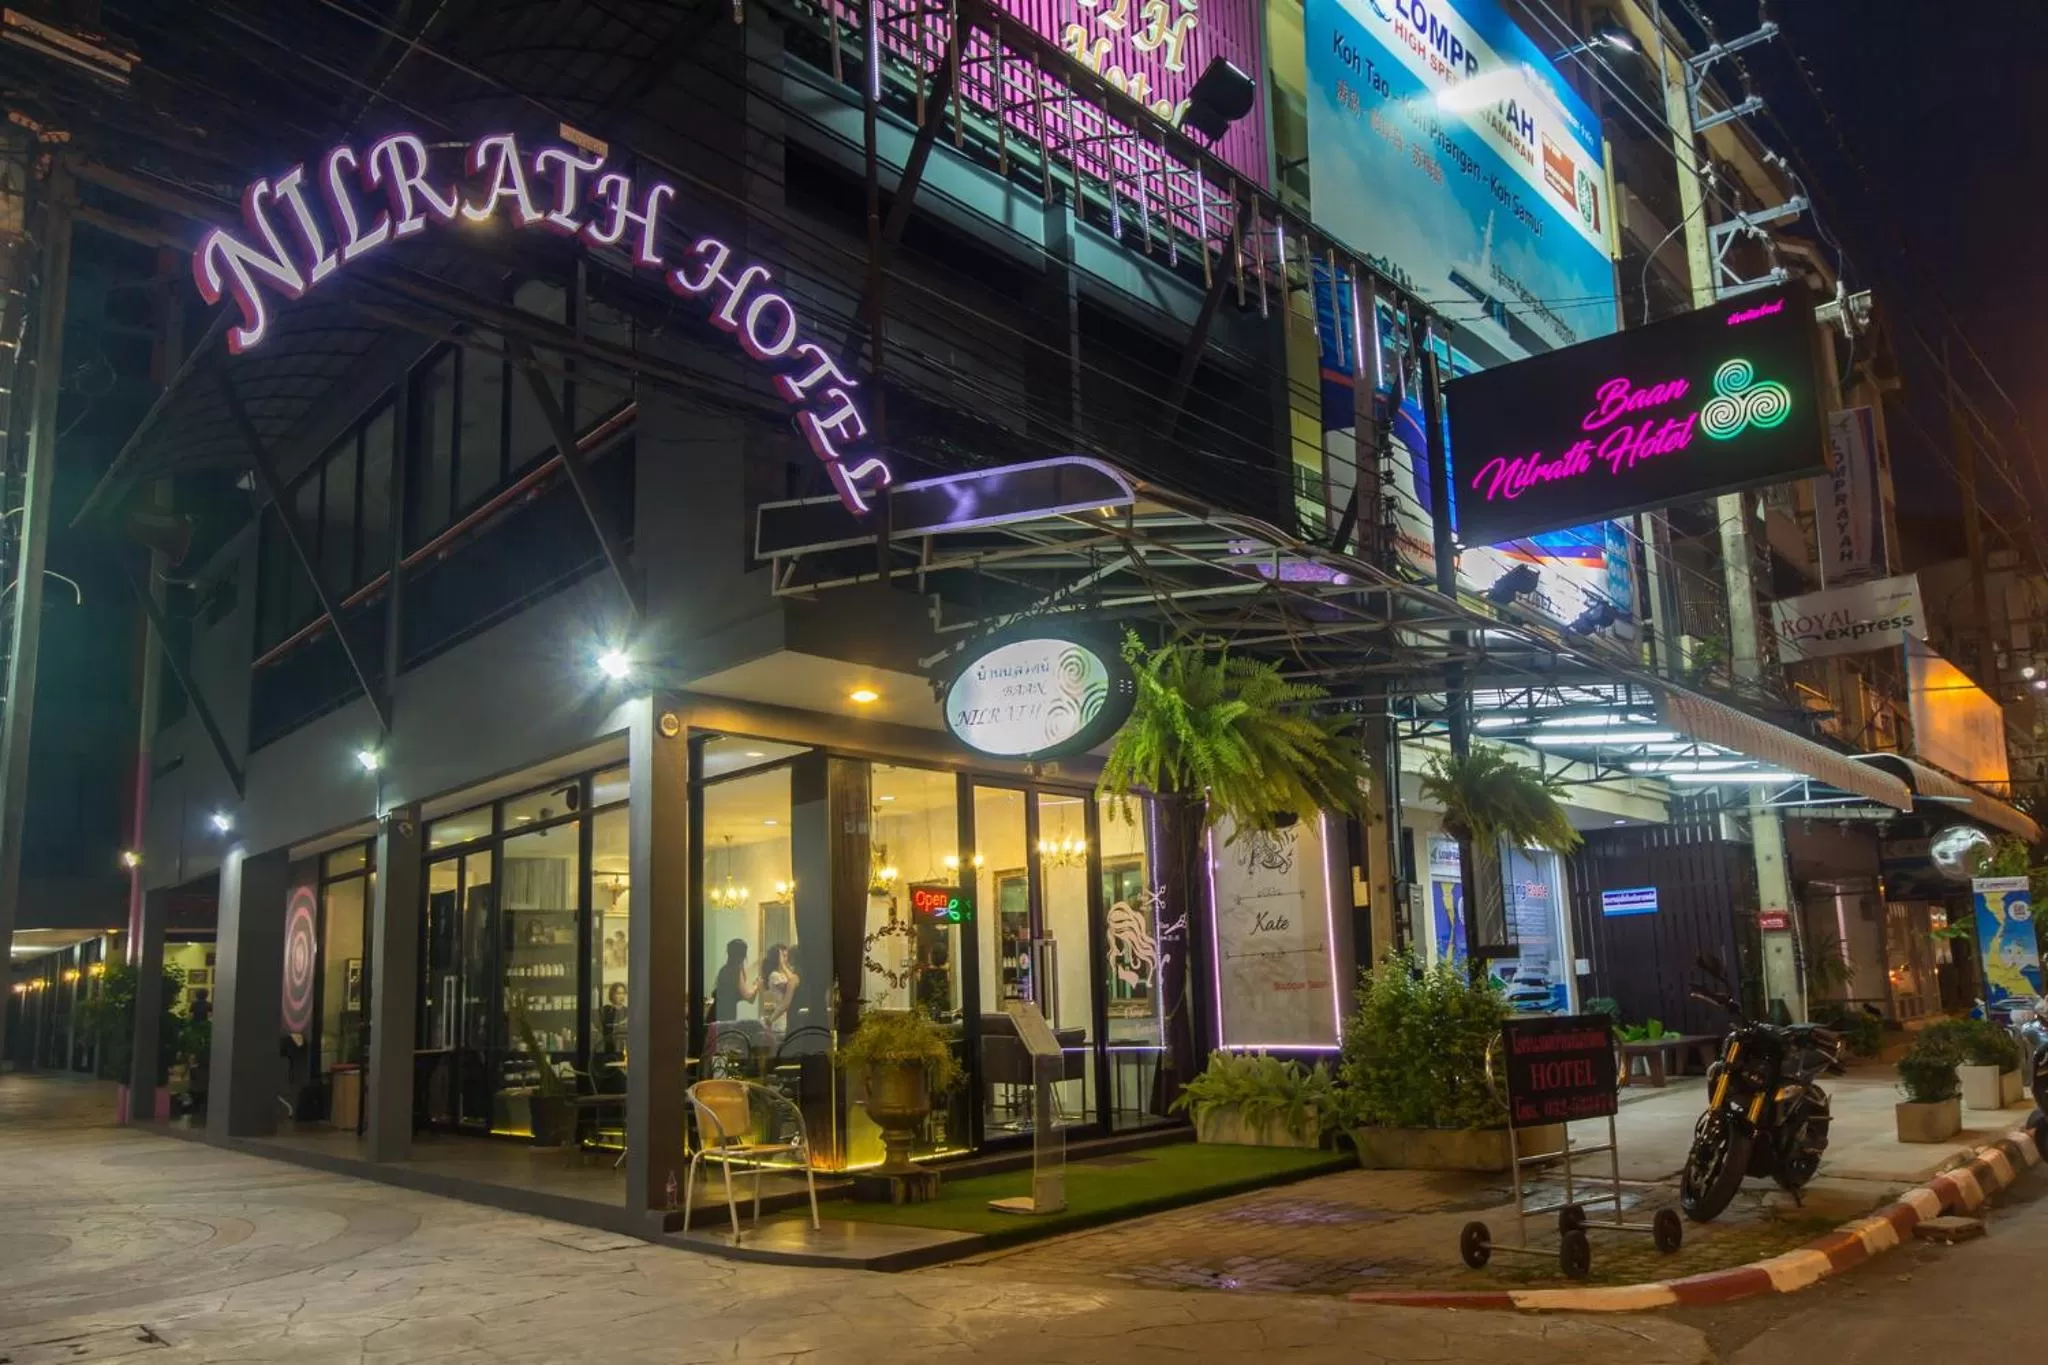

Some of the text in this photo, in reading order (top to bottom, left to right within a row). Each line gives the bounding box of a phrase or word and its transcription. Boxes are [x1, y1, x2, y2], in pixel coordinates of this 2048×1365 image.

[1395, 18, 1427, 61] HIGH
[1333, 29, 1362, 75] Koh
[1365, 57, 1390, 99] Tao
[1430, 122, 1481, 181] Phangan
[1490, 173, 1512, 211] Koh
[1512, 194, 1544, 238] Samui
[196, 132, 892, 516] NILRATH HOTEL
[1582, 376, 1690, 431] Baan
[1471, 411, 1700, 502] Nilrath Hotel
[1831, 438, 1854, 563] LOMPRAYAH
[1780, 608, 1852, 637] ROYAL
[1823, 613, 1915, 641] express
[954, 702, 1044, 727] NILRATH
[915, 890, 948, 912] Open
[1250, 909, 1290, 936] Kate
[1529, 1058, 1597, 1092] HOTEL
